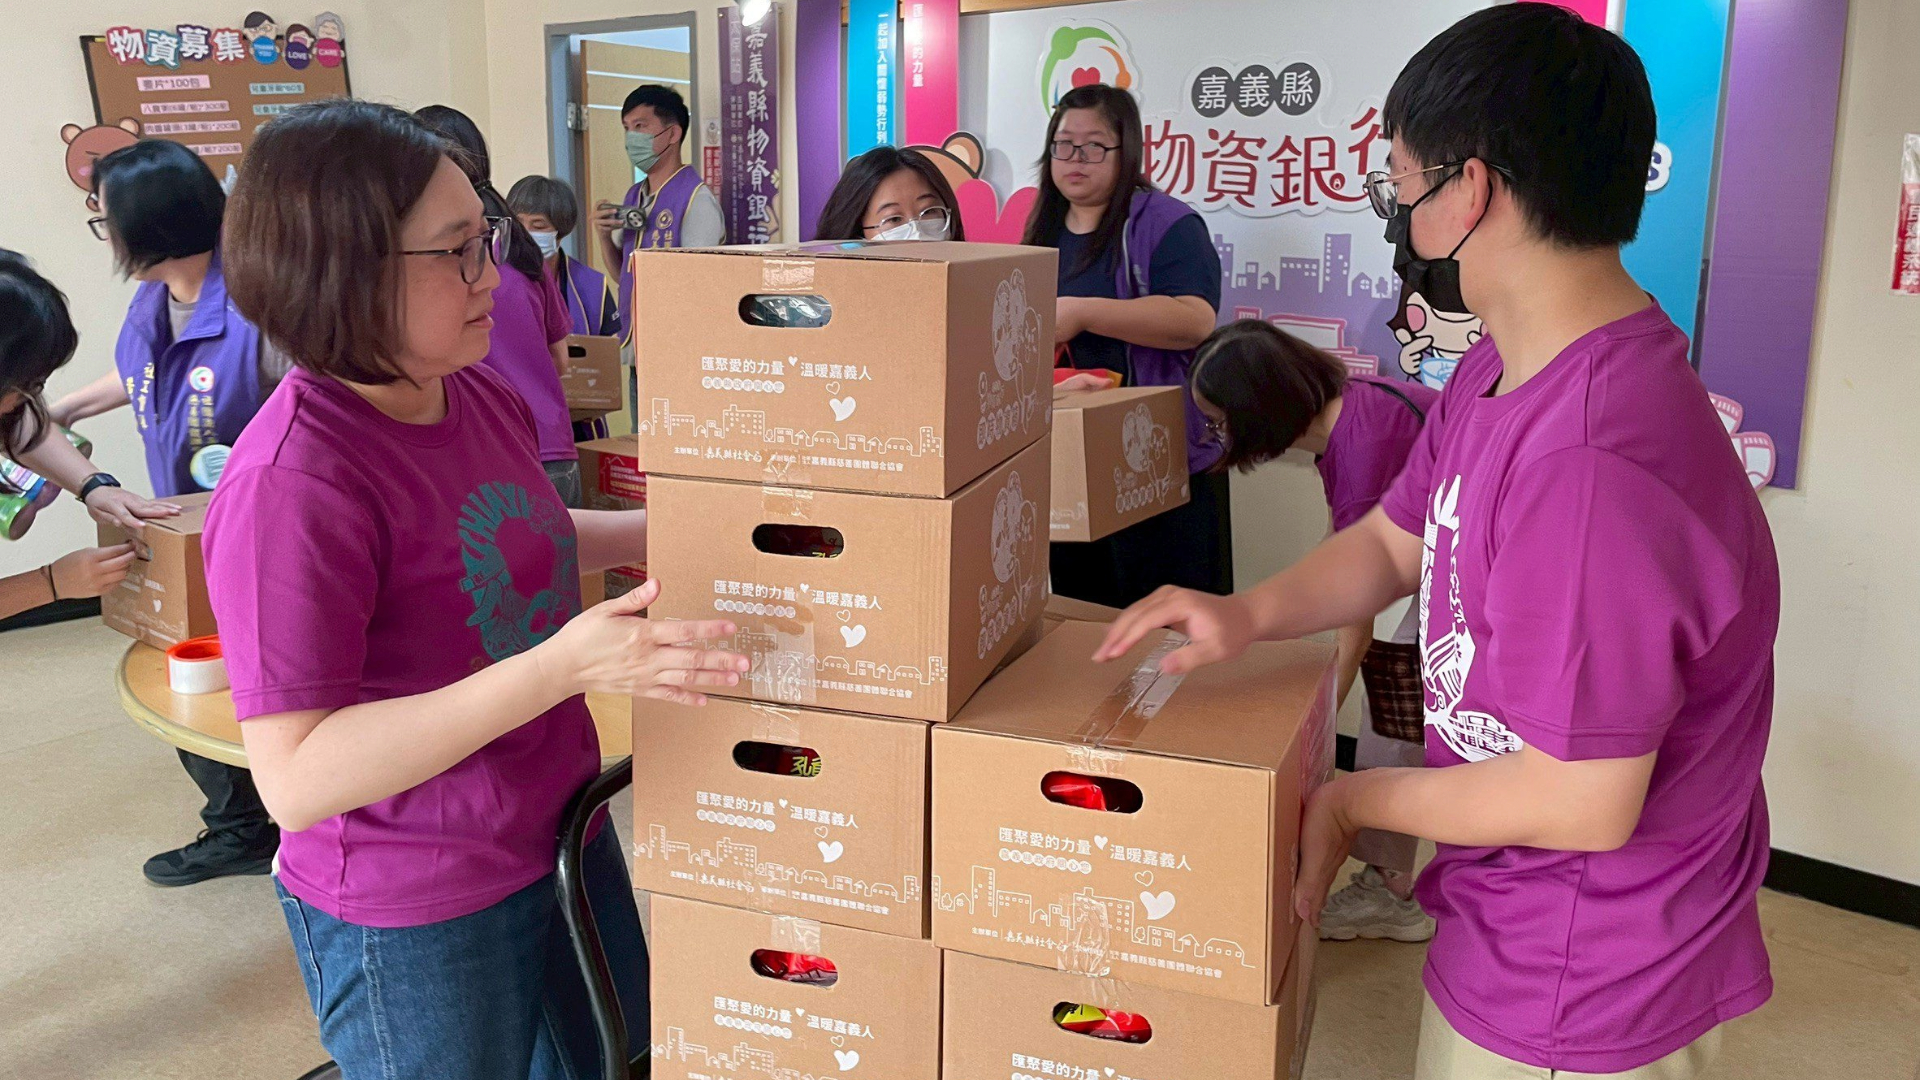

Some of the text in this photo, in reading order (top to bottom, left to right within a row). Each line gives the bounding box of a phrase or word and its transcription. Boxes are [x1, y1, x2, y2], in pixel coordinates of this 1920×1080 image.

[109, 26, 245, 66] 物資募集
[288, 51, 308, 60] LOVE
[912, 3, 924, 87] 匯的力量
[876, 13, 889, 144] 一起加入關懷弱勢行列
[1198, 69, 1314, 110] 嘉義縣
[701, 356, 872, 381] 匯聚愛的力量 溫暖嘉義人
[714, 580, 882, 611] 匯聚愛的力量 溫暖嘉義人
[696, 791, 859, 829] 匯聚愛的力量 溫暖嘉義人
[999, 827, 1192, 871] 匯聚愛的力量 溫暖嘉義人
[714, 996, 875, 1040] 匯聚愛的力量 溫暖嘉義人
